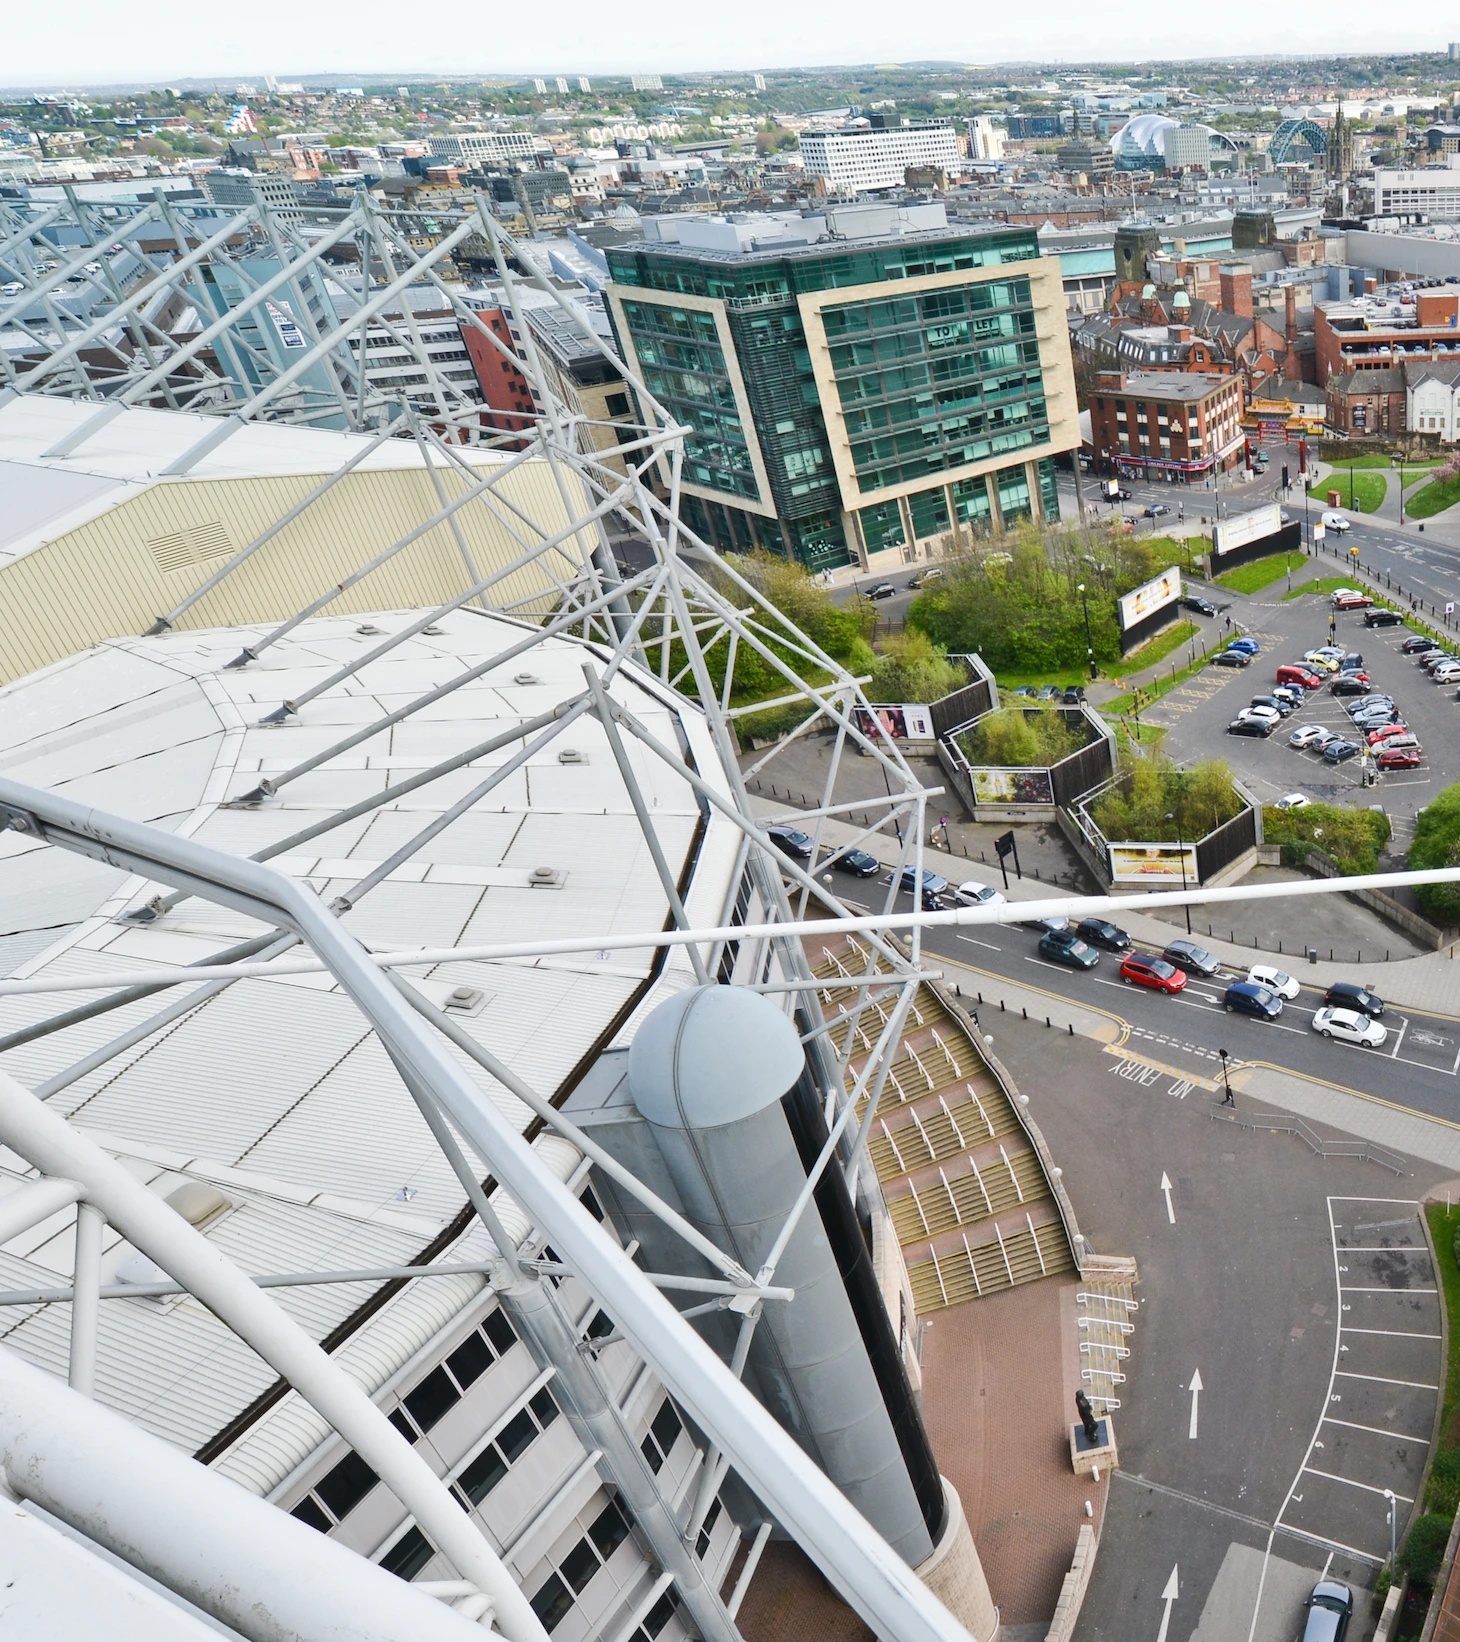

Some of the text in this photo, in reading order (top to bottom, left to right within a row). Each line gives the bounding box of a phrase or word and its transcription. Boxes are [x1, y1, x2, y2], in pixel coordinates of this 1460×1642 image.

[935, 318, 993, 337] TO LET
[1108, 1058, 1196, 1100] NO ENTRY
[1341, 1303, 1351, 1311] 3
[1339, 1344, 1350, 1352] 4
[1330, 1394, 1342, 1402] 5
[1314, 1440, 1325, 1449] 6
[1291, 1493, 1304, 1503] 7
